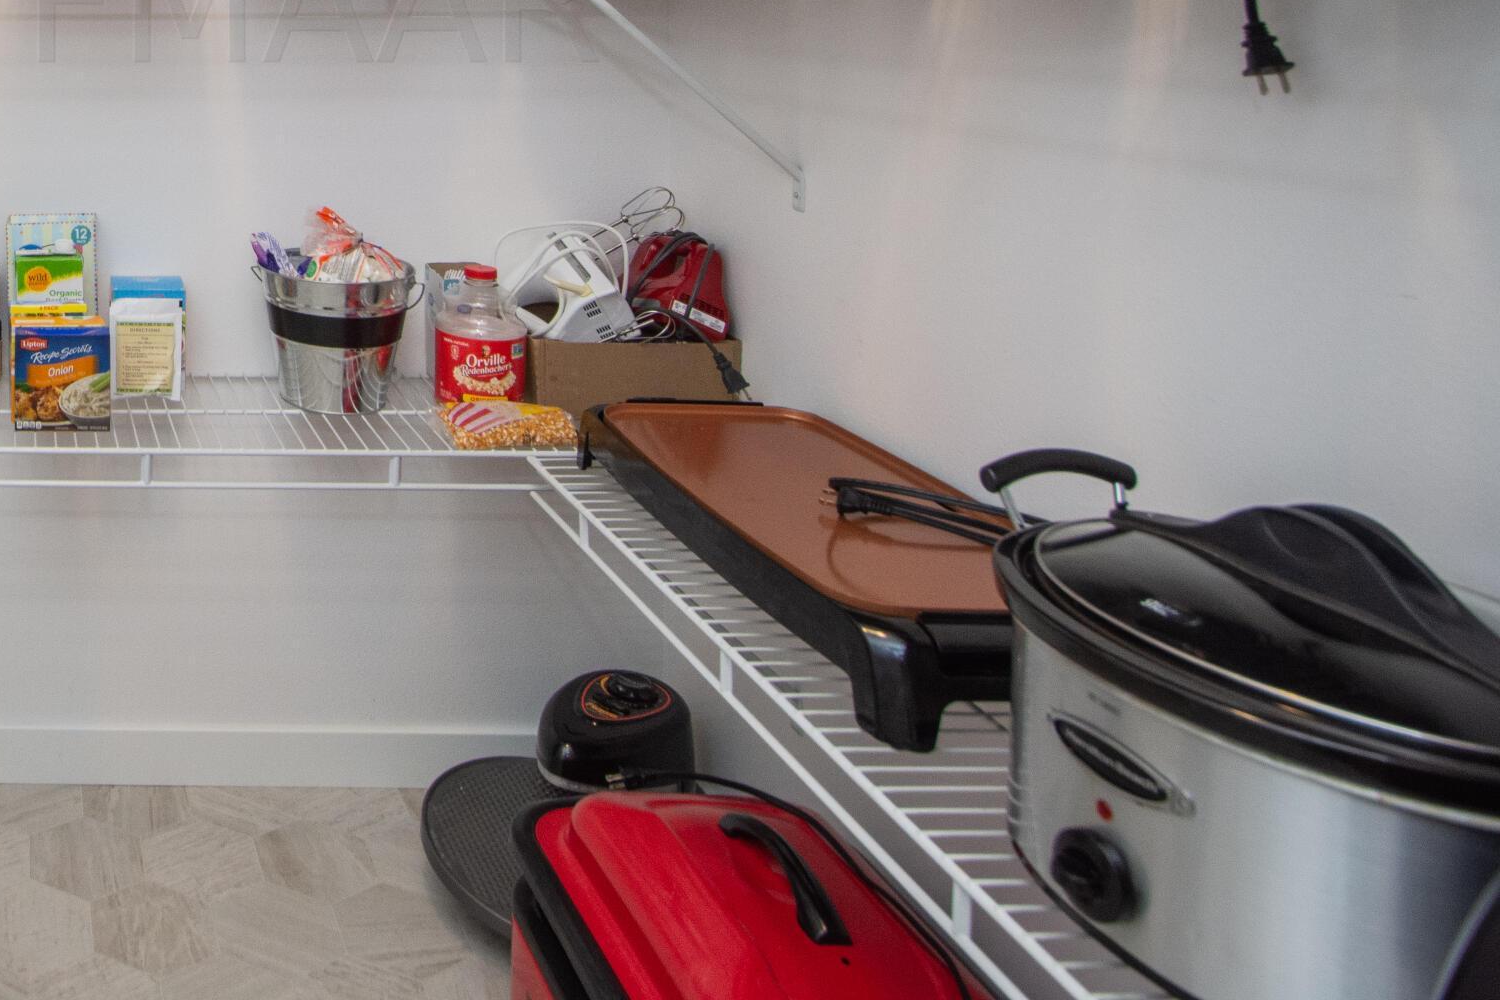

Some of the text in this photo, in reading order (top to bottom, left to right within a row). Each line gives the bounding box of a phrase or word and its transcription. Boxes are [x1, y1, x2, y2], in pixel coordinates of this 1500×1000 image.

[74, 228, 88, 239] 12
[28, 272, 47, 281] wild
[49, 290, 82, 298] Organic
[22, 340, 46, 348] Lipton
[466, 353, 506, 368] Orville
[48, 364, 74, 377] Onion
[461, 363, 512, 377] Redenbacher's
